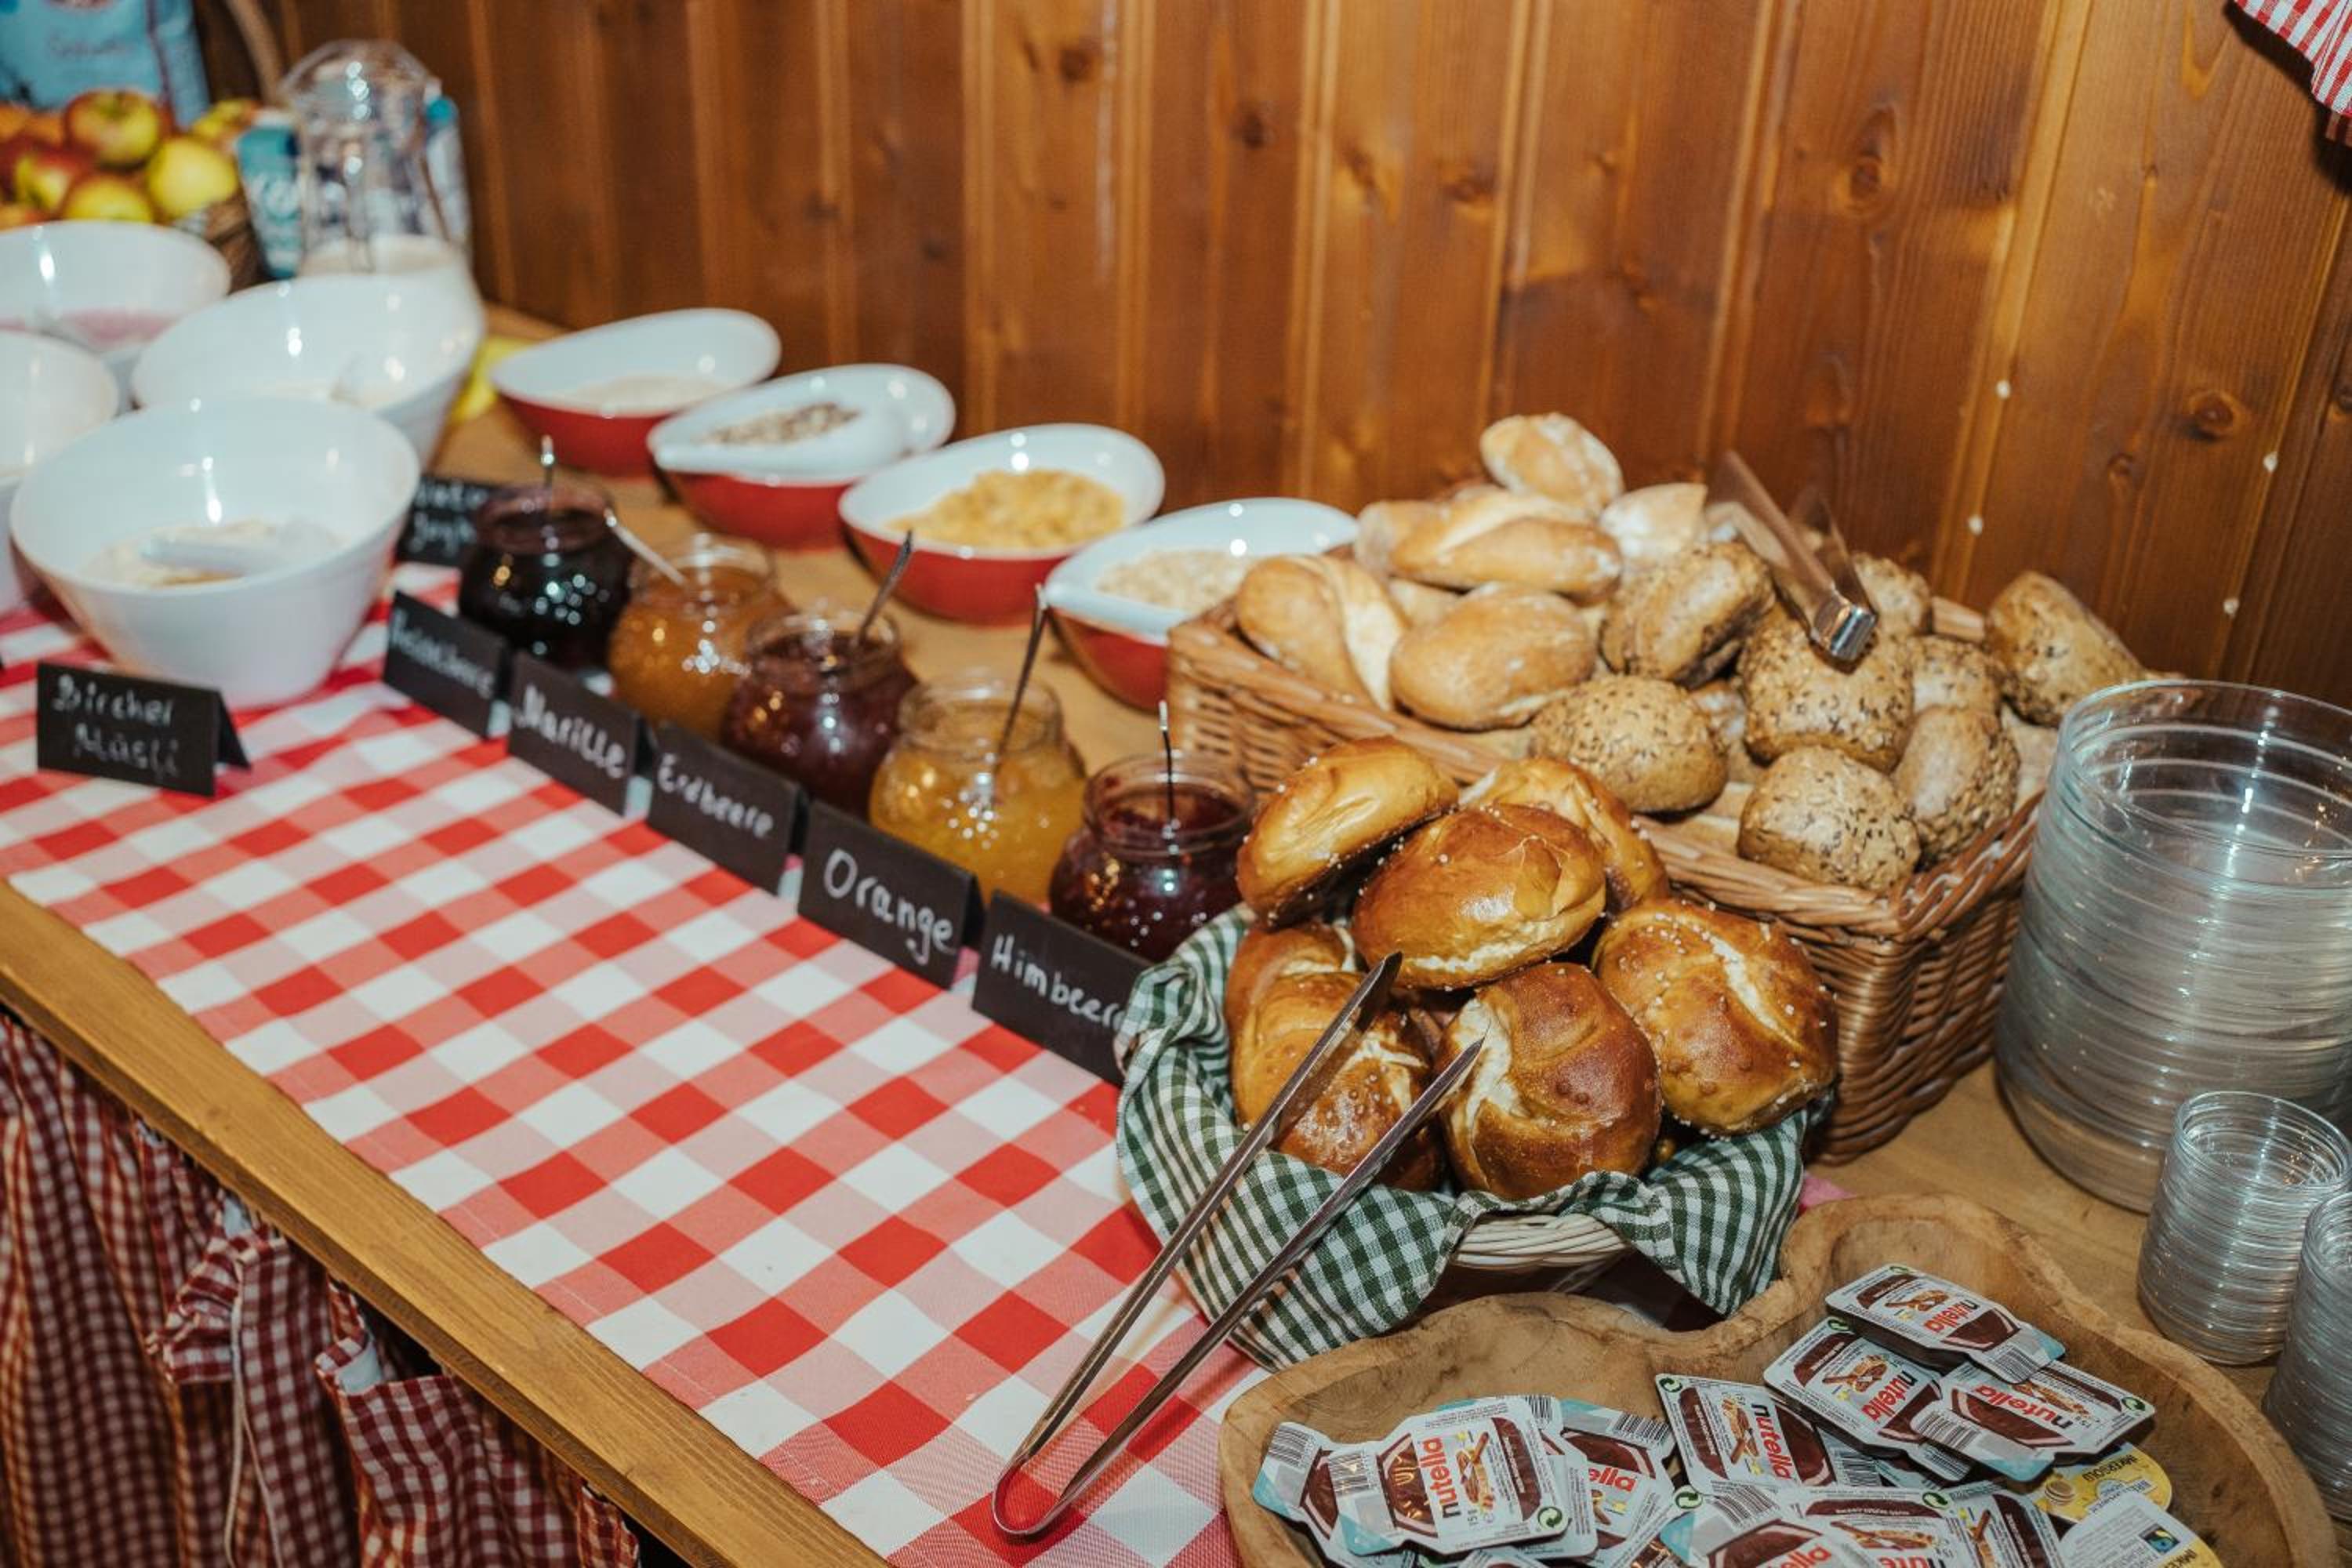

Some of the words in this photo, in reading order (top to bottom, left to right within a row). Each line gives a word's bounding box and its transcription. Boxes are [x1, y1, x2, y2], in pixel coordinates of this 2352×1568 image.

[53, 673, 174, 725] Bircher
[512, 684, 626, 779] Marille
[657, 751, 773, 838] Erdbeere
[823, 848, 956, 965] Orange
[1924, 1298, 1981, 1334] nutella
[1862, 1370, 1917, 1421] nutella
[1973, 1383, 2071, 1430] nutella
[1751, 1403, 1794, 1479] nutella
[1420, 1436, 1461, 1519] nutella
[1588, 1466, 1638, 1493] ella
